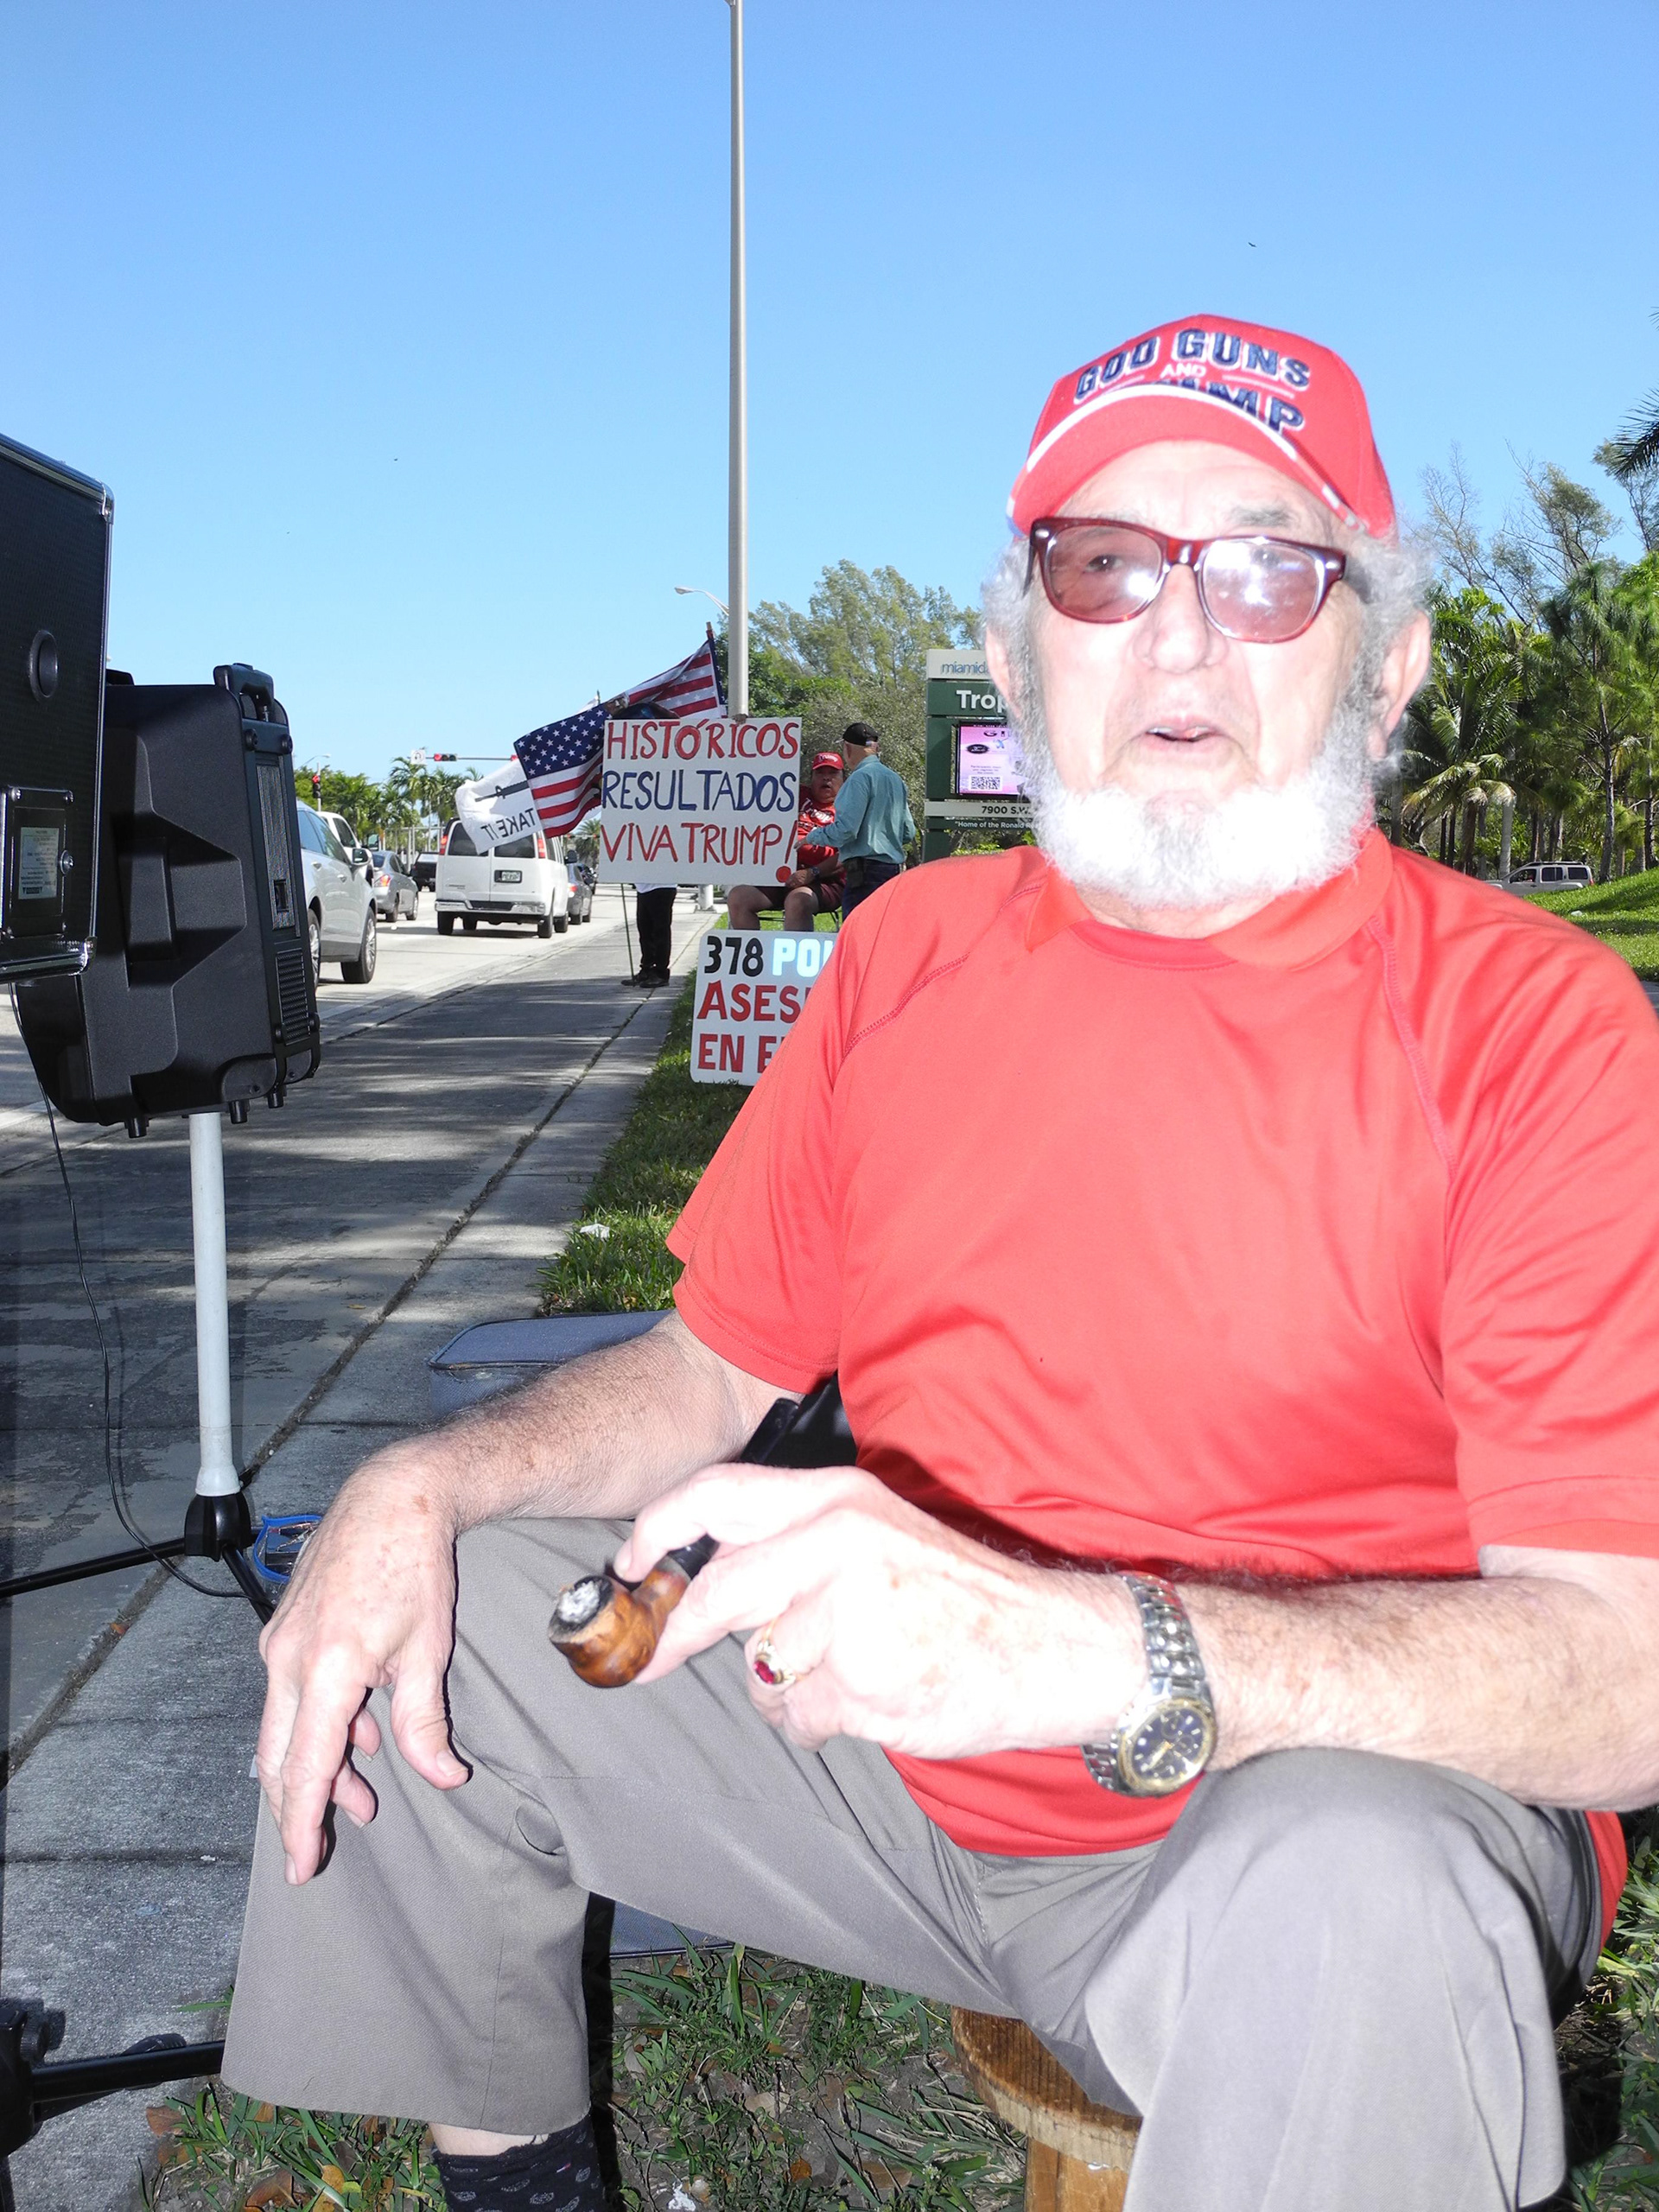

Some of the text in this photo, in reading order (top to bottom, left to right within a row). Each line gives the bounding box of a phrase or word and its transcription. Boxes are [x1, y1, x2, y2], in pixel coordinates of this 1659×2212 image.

[1074, 327, 1311, 404] GOD GUNS
[1160, 363, 1206, 378] AND
[601, 770, 798, 812] RESULTADOS
[601, 820, 798, 883] VIVA TRUMP!
[704, 936, 764, 977] 378
[696, 980, 811, 1024] ASES
[697, 1033, 745, 1073] EN
